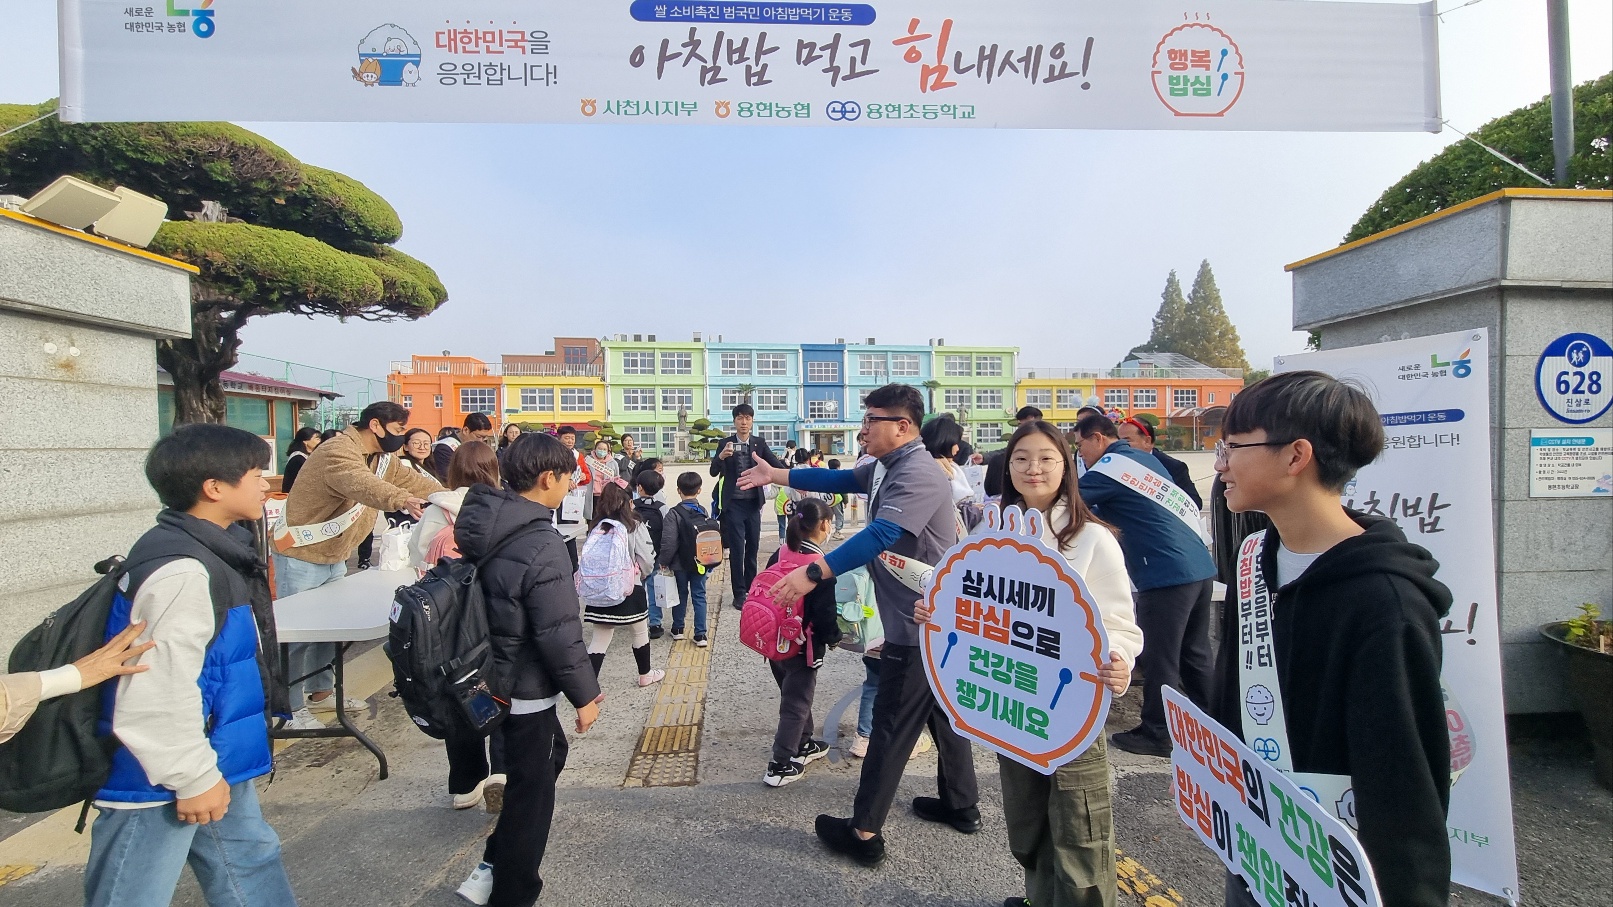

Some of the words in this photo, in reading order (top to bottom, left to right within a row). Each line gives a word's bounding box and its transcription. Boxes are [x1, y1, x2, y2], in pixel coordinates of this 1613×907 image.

[124, 6, 154, 17] 새로운
[654, 4, 667, 19] 쌀
[670, 5, 720, 19] 소비촉진
[723, 6, 760, 20] 범국민
[763, 7, 825, 21] 아침밥먹기
[828, 8, 853, 21] 운동
[124, 21, 164, 33] 대한민국
[167, 21, 186, 33] 농협
[435, 28, 551, 55] 대한민국을
[629, 26, 780, 87] 아침밥
[795, 32, 880, 87] 먹고
[892, 17, 1095, 94] 힘내세요!
[1167, 48, 1211, 71] 행복
[436, 61, 558, 87] 응원합니다!
[1168, 75, 1211, 97] 밥심
[602, 99, 698, 117] 사천시지부
[736, 100, 811, 119] 용현농협
[866, 102, 976, 120] 용현초등학교
[1398, 363, 1422, 372] 새로운
[1398, 370, 1429, 381] 대한민국
[1431, 369, 1447, 378] 농협
[1555, 370, 1602, 395] 628
[1427, 412, 1447, 422] 운동
[961, 569, 1056, 618] 삼시세끼
[955, 596, 1061, 661] 밥심으로
[968, 645, 1038, 696] 건강을
[956, 678, 1050, 741] 챙기세요
[1166, 698, 1271, 828] 대한민국의
[1268, 780, 1368, 907] 건강은
[1175, 764, 1234, 863] 밥심이
